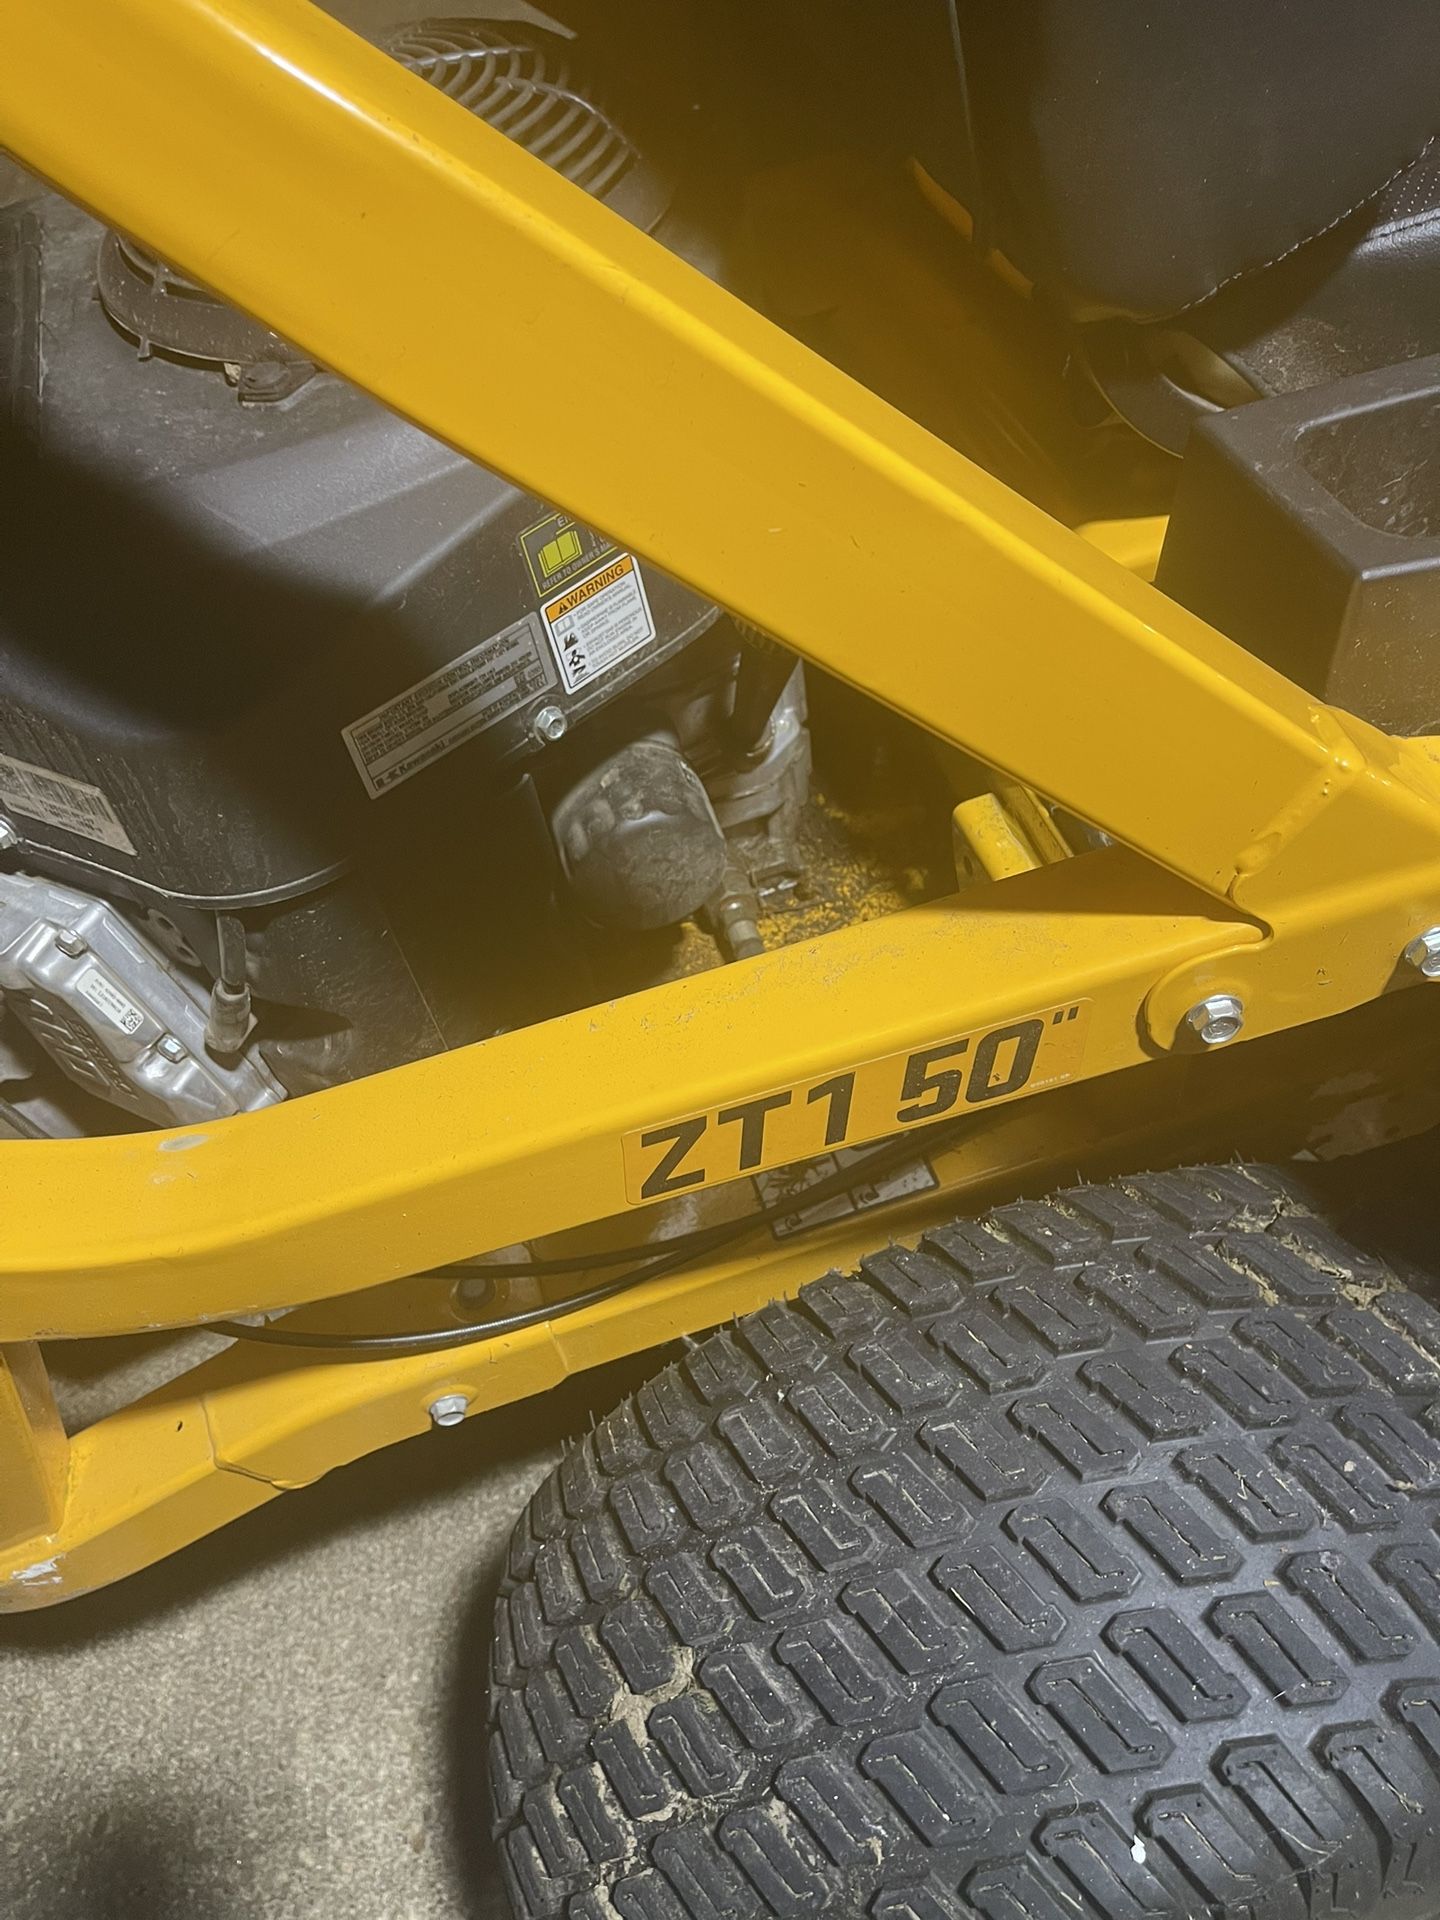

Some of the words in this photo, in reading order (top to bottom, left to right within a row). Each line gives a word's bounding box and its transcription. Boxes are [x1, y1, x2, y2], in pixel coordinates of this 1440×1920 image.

[566, 564, 625, 608] WARNING
[641, 1072, 856, 1199] ZT1
[896, 1006, 1080, 1122] 50"
